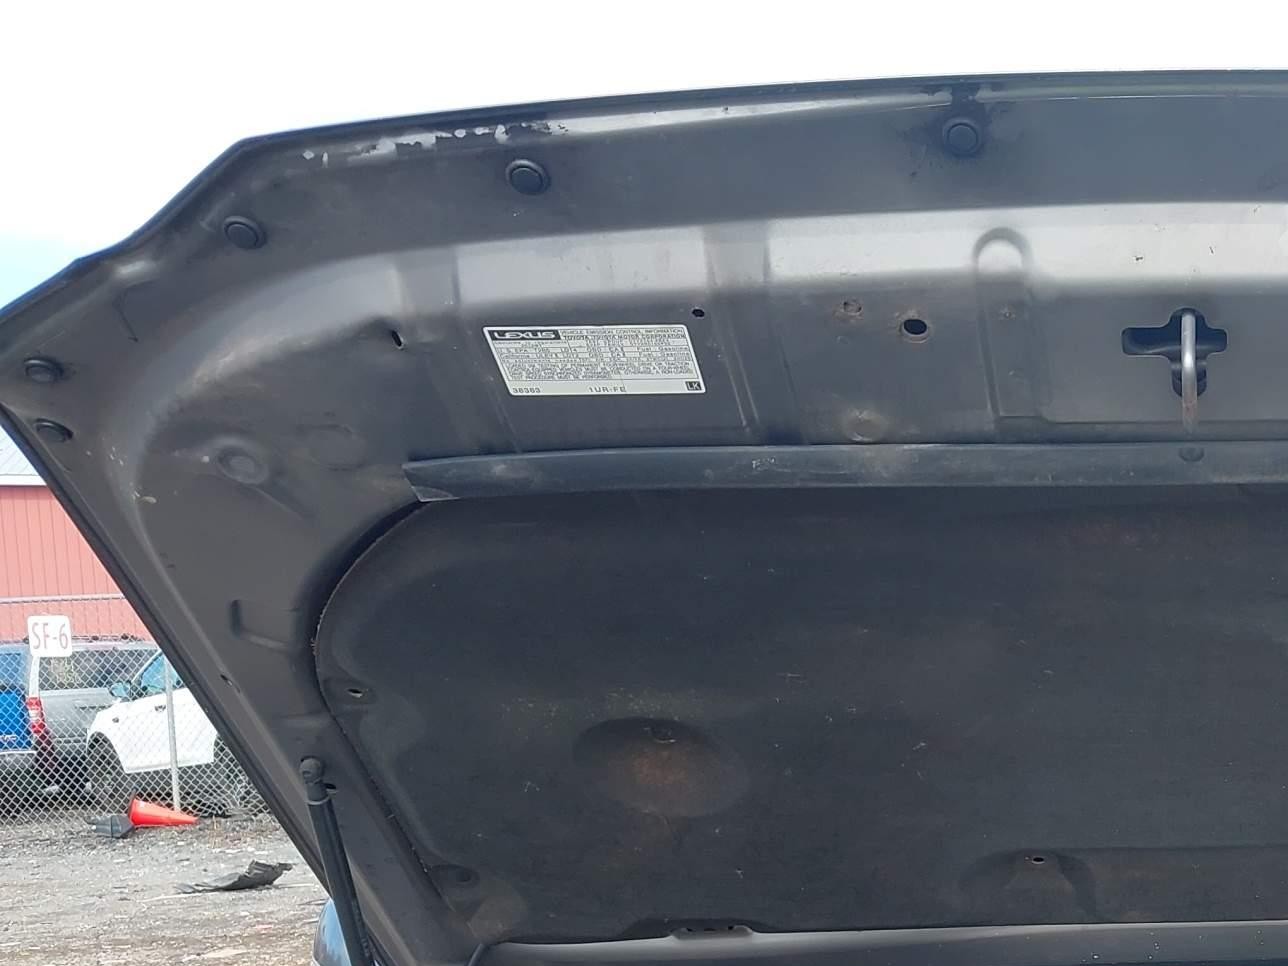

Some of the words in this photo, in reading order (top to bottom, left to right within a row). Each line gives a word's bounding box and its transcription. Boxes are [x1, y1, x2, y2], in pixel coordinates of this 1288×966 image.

[494, 331, 555, 339] LEXUS
[688, 381, 701, 390] LK
[31, 621, 69, 650] SF-6
